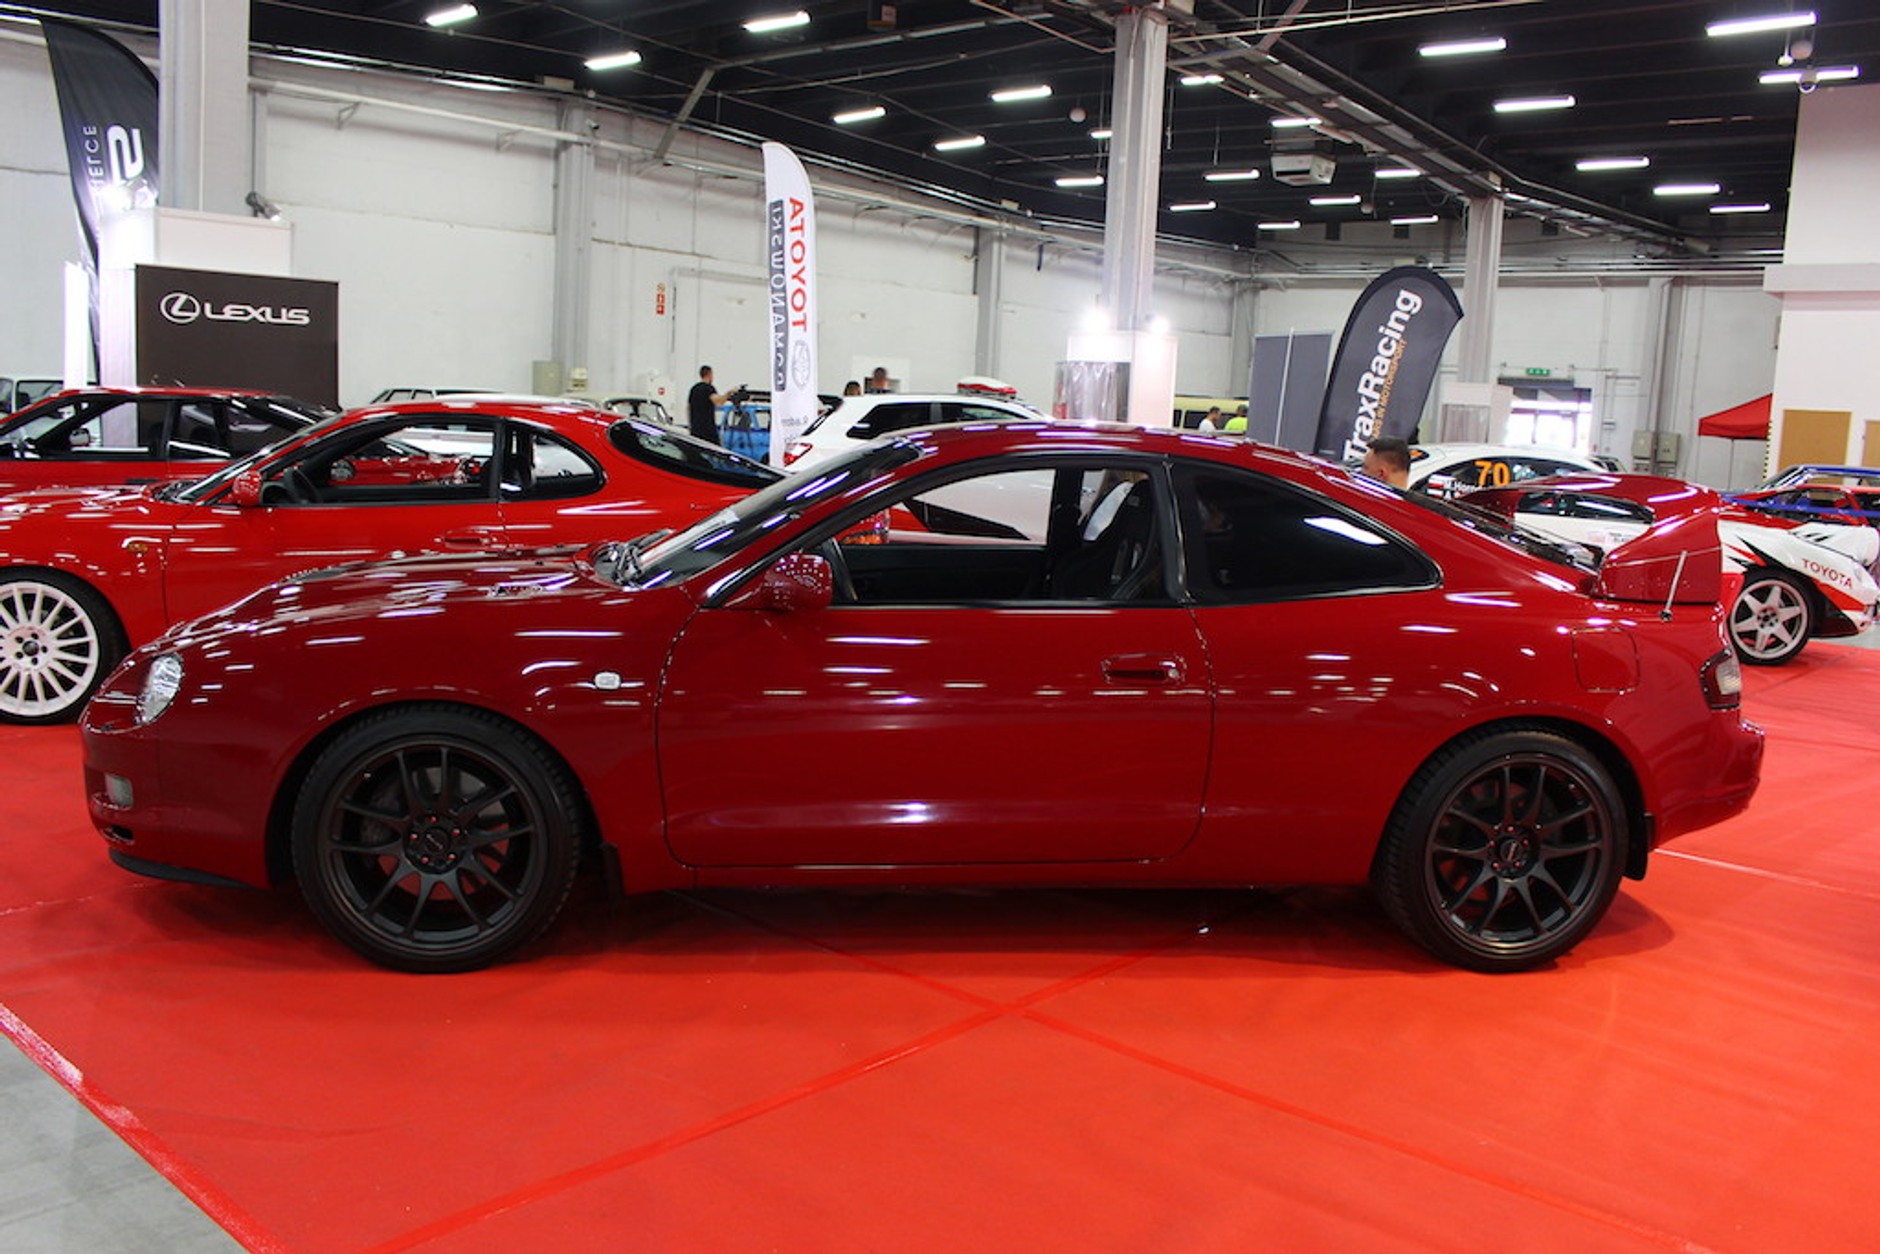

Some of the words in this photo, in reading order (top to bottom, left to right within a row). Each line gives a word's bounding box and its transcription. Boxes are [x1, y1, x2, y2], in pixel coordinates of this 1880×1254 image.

[204, 302, 310, 325] LEXUS
[1343, 289, 1422, 461] TraxRacing
[1474, 460, 1510, 487] 70
[1802, 558, 1853, 590] TOYOTA
